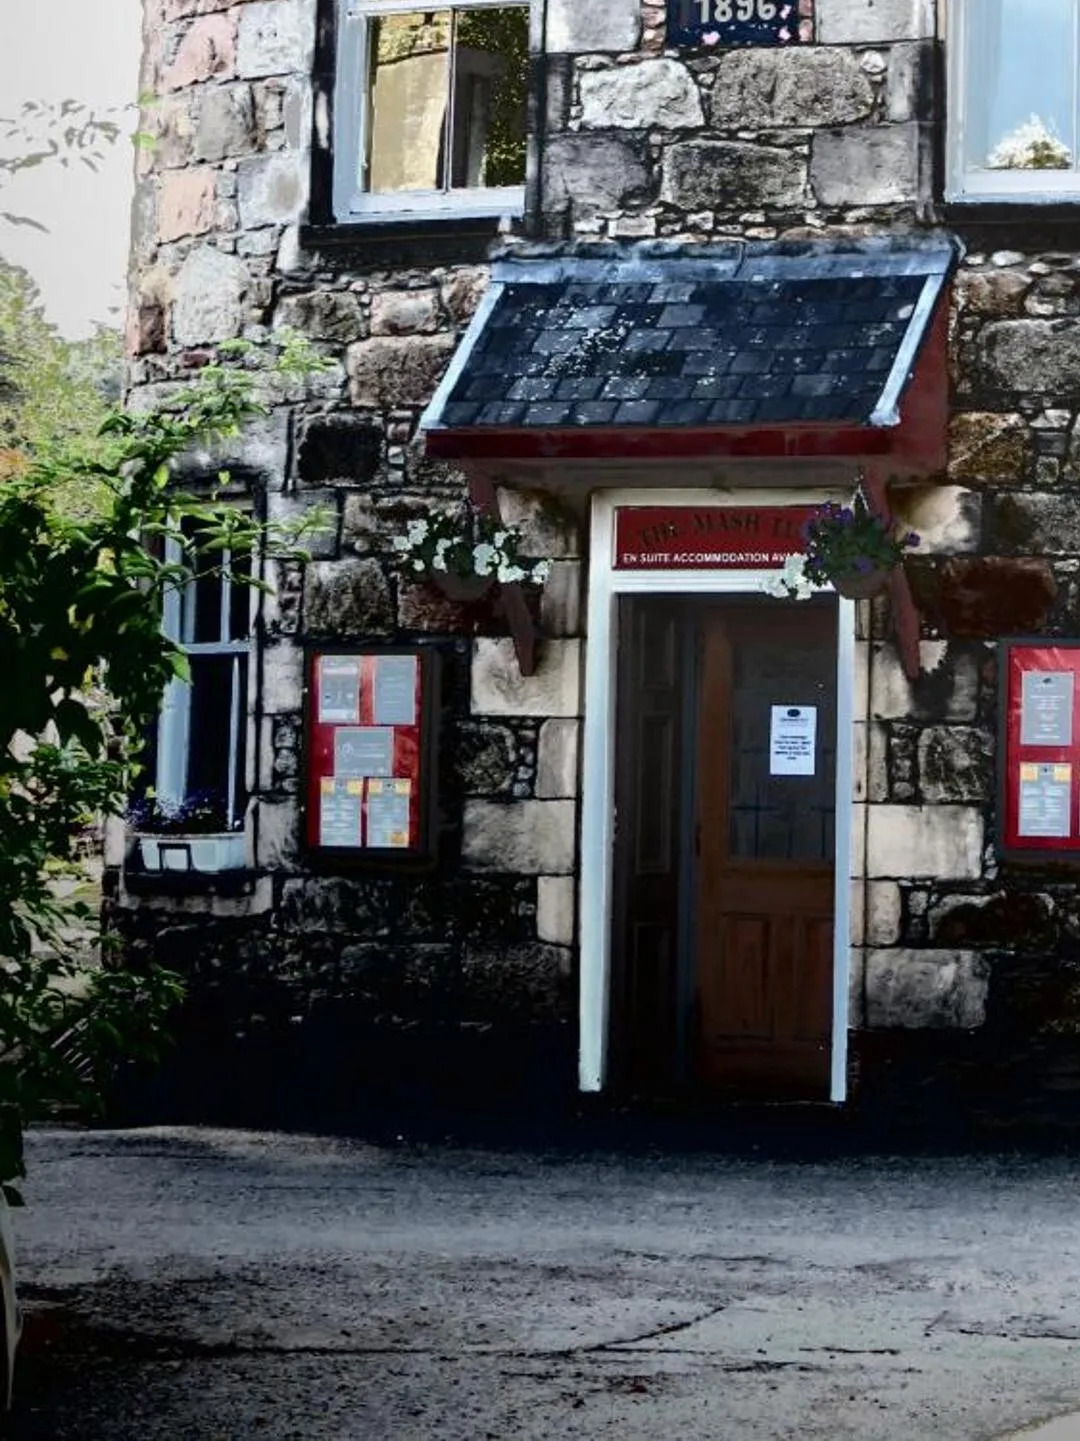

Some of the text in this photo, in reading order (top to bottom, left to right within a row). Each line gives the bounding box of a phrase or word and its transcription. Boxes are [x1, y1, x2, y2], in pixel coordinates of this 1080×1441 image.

[622, 552, 637, 564] EN
[640, 552, 671, 564] SUITE
[673, 552, 770, 563] ACCOMMODATION
